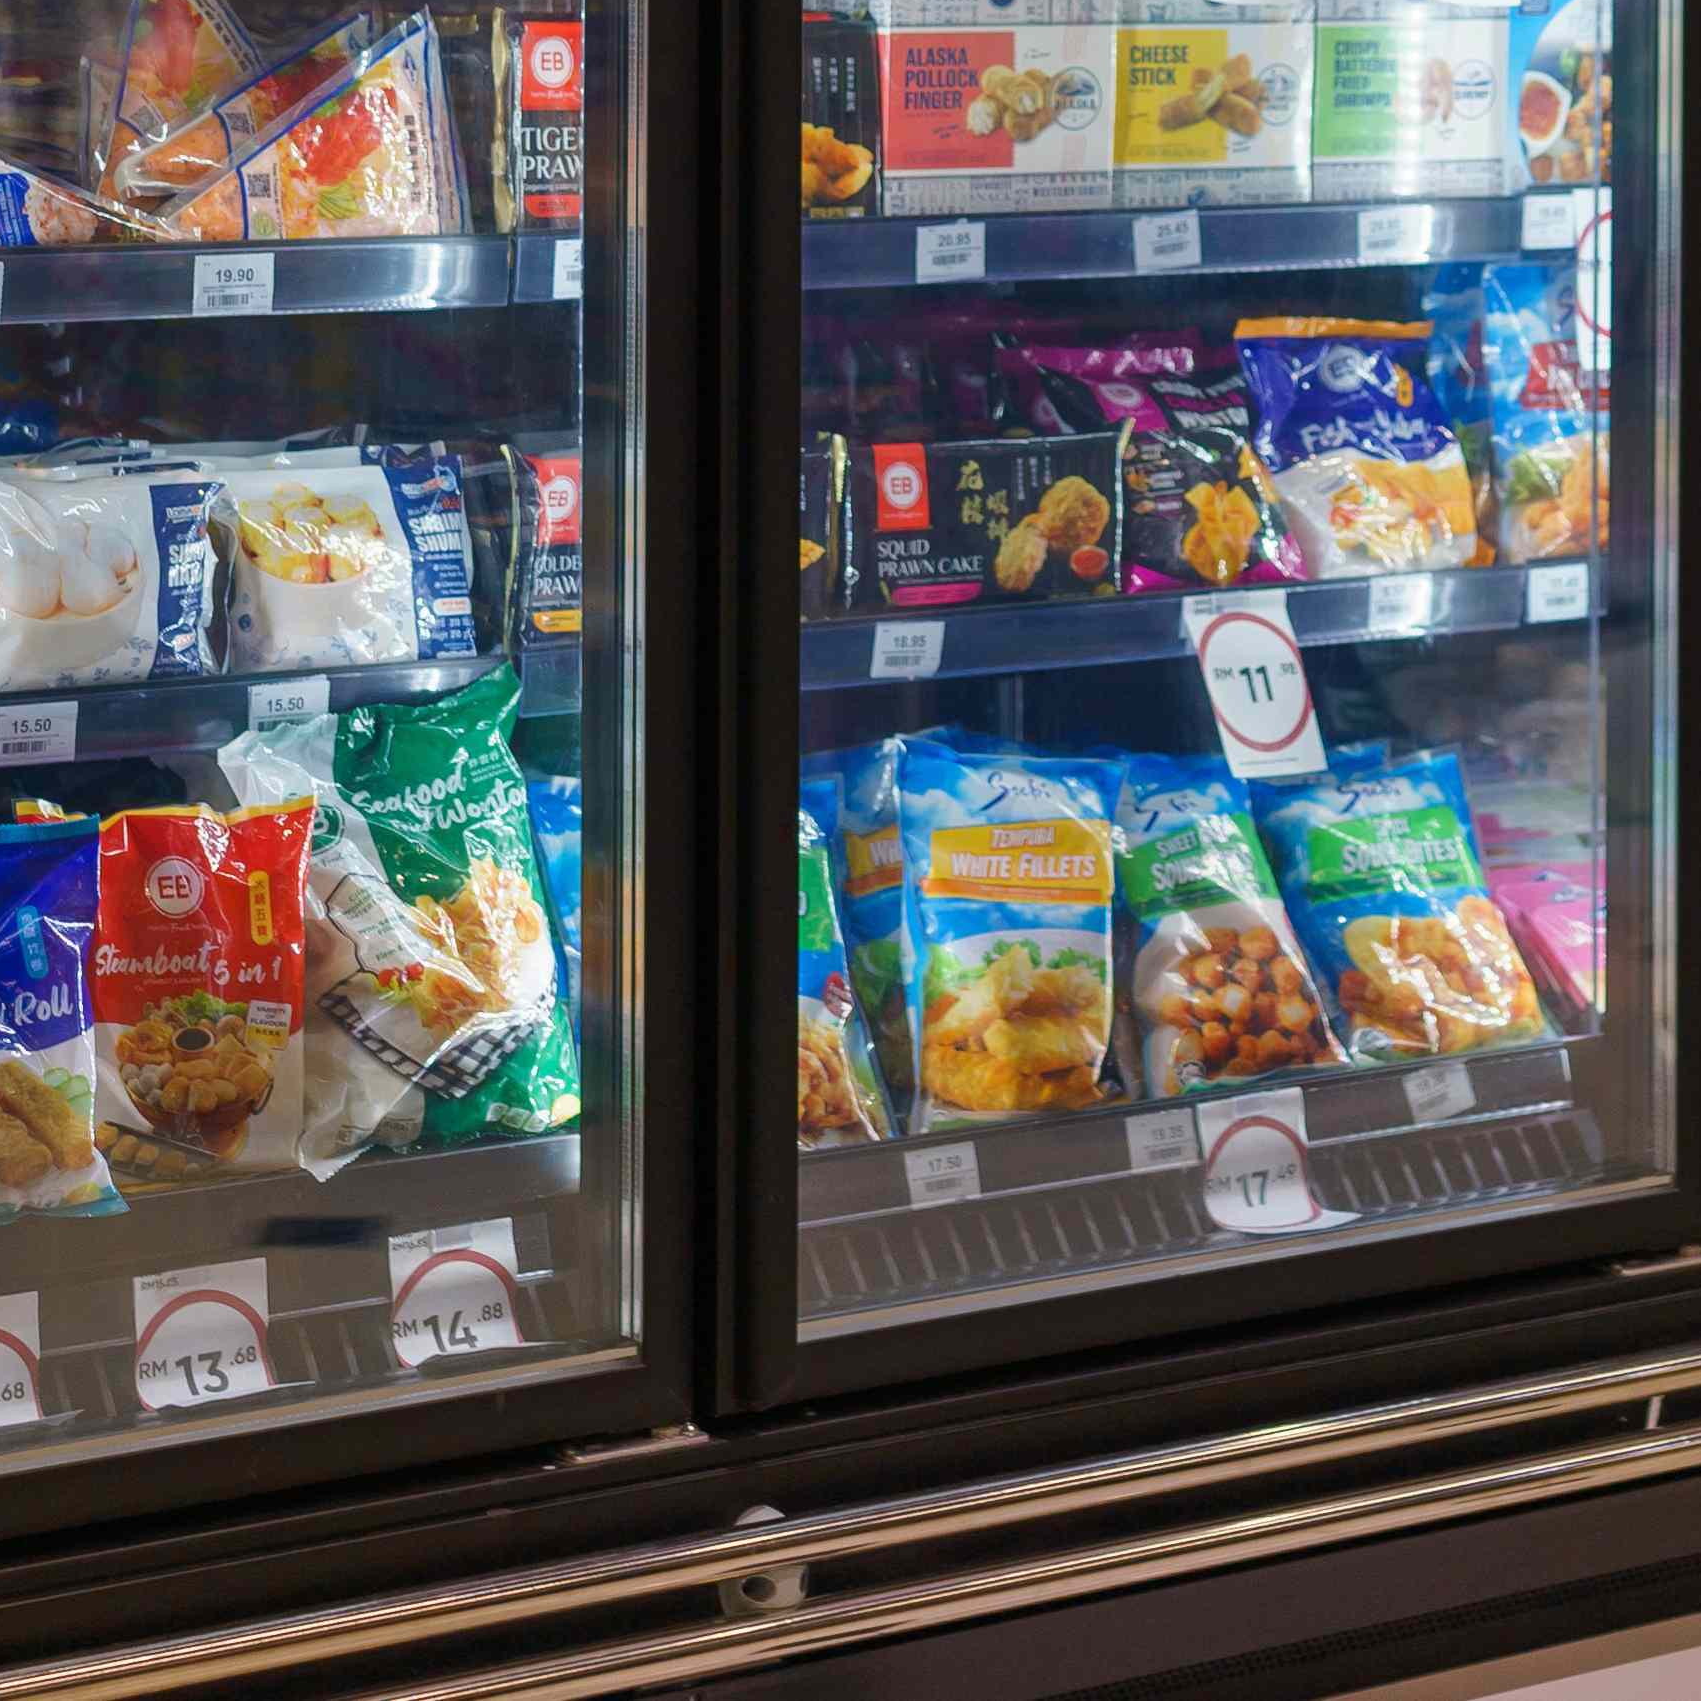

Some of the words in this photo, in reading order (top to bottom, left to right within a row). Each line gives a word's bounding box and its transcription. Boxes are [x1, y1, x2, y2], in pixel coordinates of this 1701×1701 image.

[540, 50, 565, 72] EB
[906, 47, 969, 67] ALASKA
[1129, 45, 1190, 64] CHEESE
[904, 69, 980, 89] POLLOCK
[1129, 67, 1177, 87] STICK
[903, 90, 963, 111] FINGER
[214, 267, 255, 285] 19.90
[877, 539, 930, 558] SQUID
[878, 559, 935, 578] PRAWN
[938, 555, 984, 573] CAKE
[1238, 665, 1273, 703] 11
[265, 696, 305, 713] 15.50
[9, 715, 53, 734] 15.50
[950, 854, 1012, 880] WHITE
[1018, 854, 1096, 878] FILLETS
[94, 939, 221, 977] Steamboat
[213, 959, 231, 986] 5
[236, 959, 267, 984] in
[271, 956, 283, 981] 1
[13, 982, 74, 1027] Roll
[1237, 1170, 1270, 1208] 17
[392, 1318, 419, 1340] RM
[422, 1310, 478, 1353] 14
[476, 1302, 504, 1323] .88
[138, 1359, 168, 1380] RM
[175, 1351, 229, 1395] 13
[229, 1345, 257, 1366] .68
